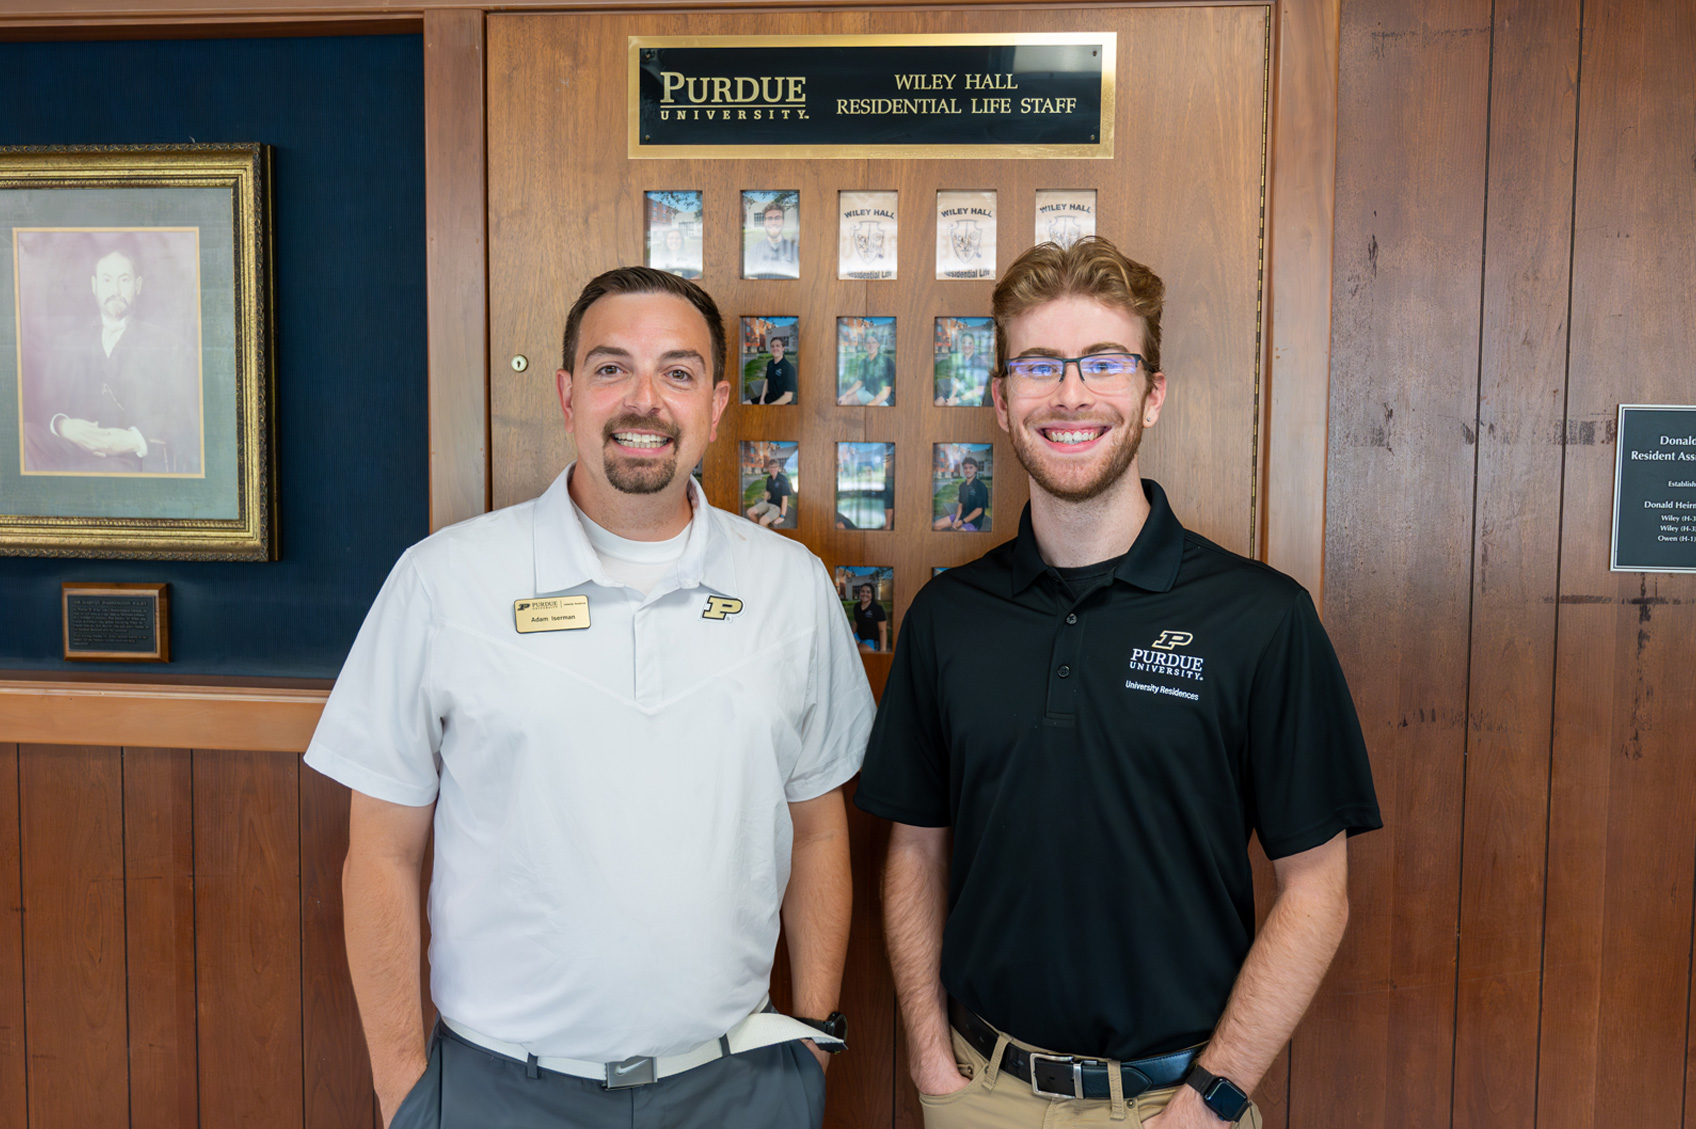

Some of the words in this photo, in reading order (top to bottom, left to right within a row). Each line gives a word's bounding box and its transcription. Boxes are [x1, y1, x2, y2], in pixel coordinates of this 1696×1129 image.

[660, 72, 806, 103] PURDUE
[894, 74, 957, 90] WILEY
[965, 74, 1019, 89] HALL
[836, 98, 962, 115] RESIDENTIAL
[971, 98, 1011, 114] LIFE
[1020, 98, 1077, 114] STAFF
[660, 109, 809, 120] UNIVERSITY
[941, 208, 969, 218] WILEY
[970, 208, 992, 218] HALL
[1039, 203, 1067, 214] WILEY
[1069, 203, 1091, 214] HALL
[844, 209, 872, 219] WILEY
[873, 209, 895, 220] HALL
[1631, 450, 1676, 461] Resident
[1644, 500, 1674, 509] Donald
[1660, 514, 1680, 524] Wiley
[1659, 524, 1679, 534] Wiley
[1657, 534, 1678, 542] Owen
[702, 595, 744, 621] P
[1151, 629, 1194, 651] P
[1130, 648, 1204, 672] PURDUE
[1129, 661, 1203, 681] UNIVERSITY
[1125, 680, 1160, 694] University
[1159, 685, 1199, 701] Residences
